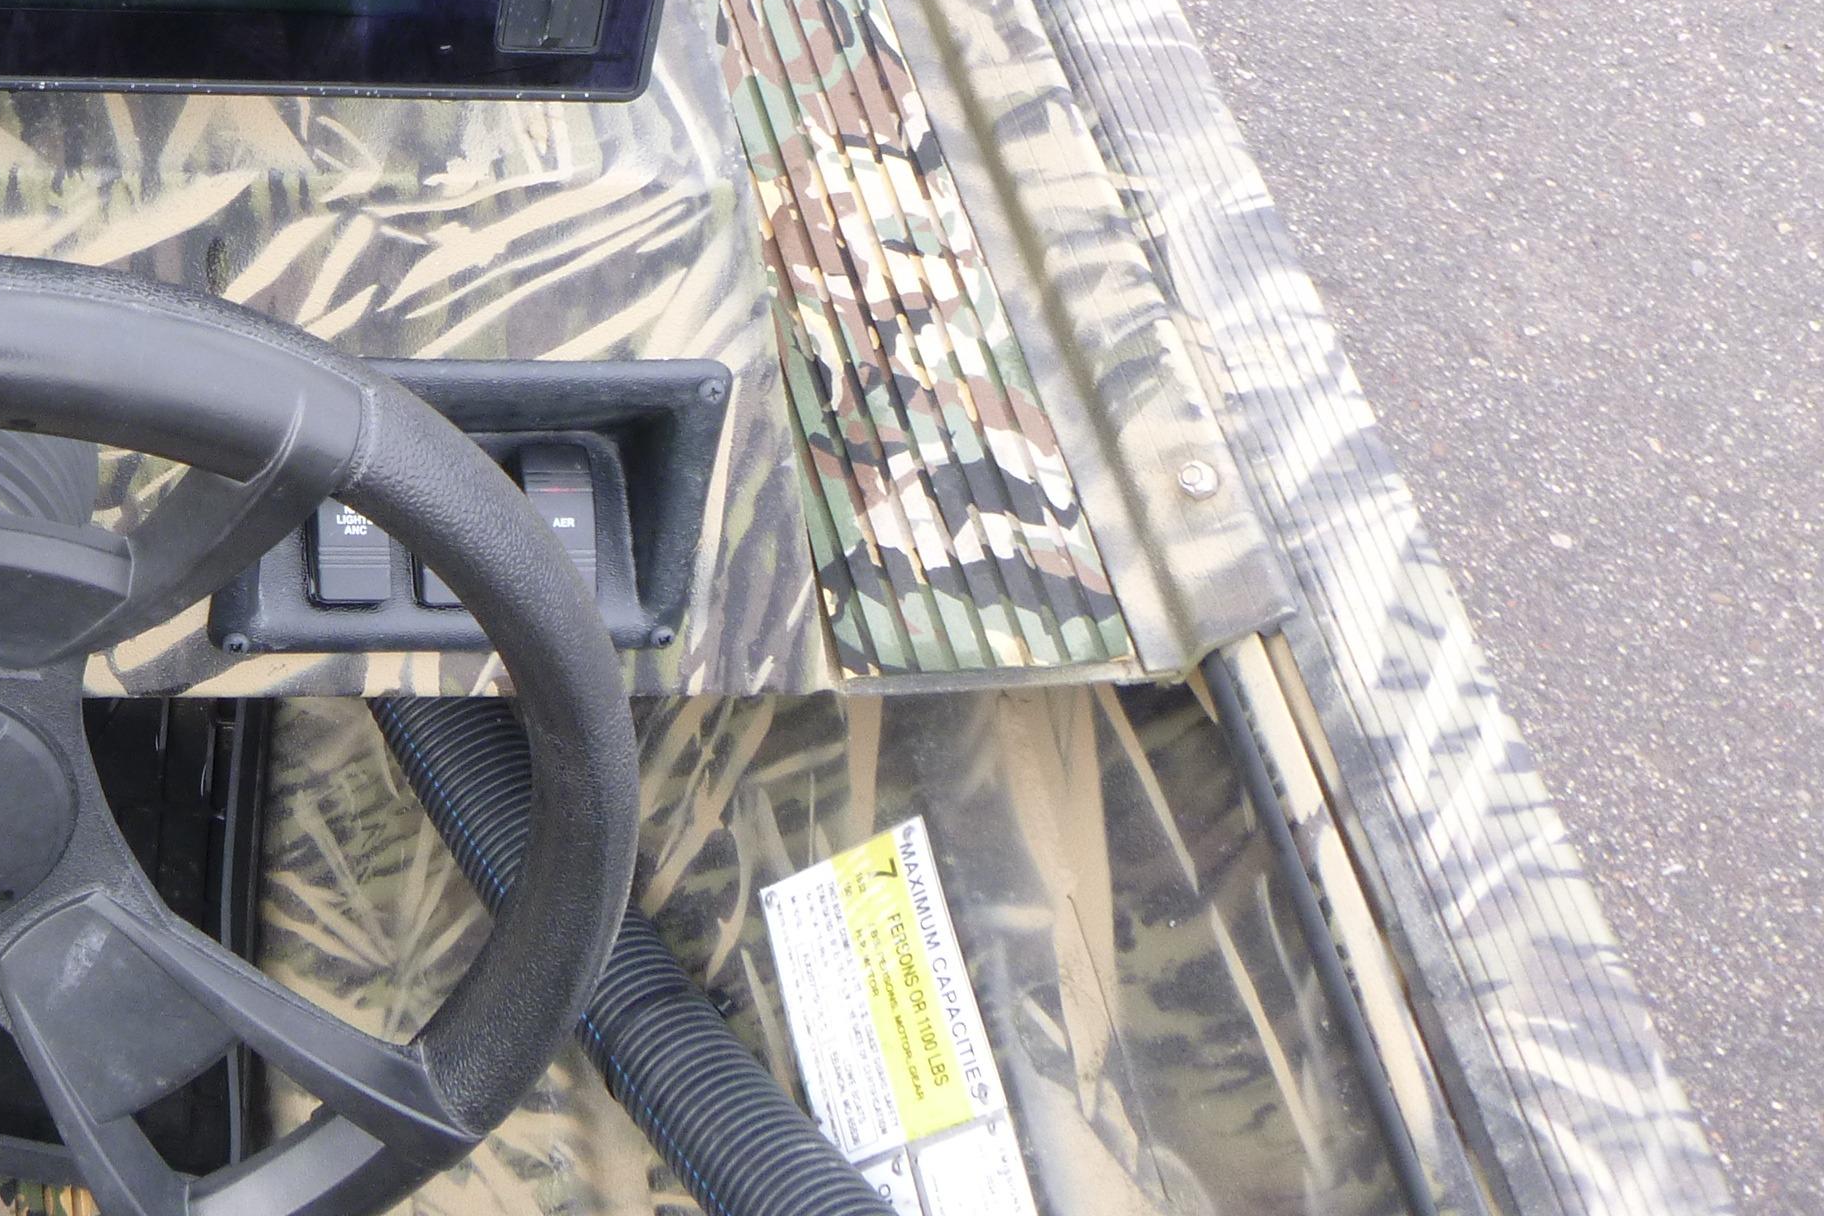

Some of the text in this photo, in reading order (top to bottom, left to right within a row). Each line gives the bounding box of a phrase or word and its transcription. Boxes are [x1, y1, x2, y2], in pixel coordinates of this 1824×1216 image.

[344, 525, 368, 536] ANC
[552, 517, 576, 528] AER
[900, 842, 940, 950] MAXIMUM
[874, 857, 947, 1087] 7 PERSONS OR 1100 LBS
[908, 1064, 924, 1101] GEAR
